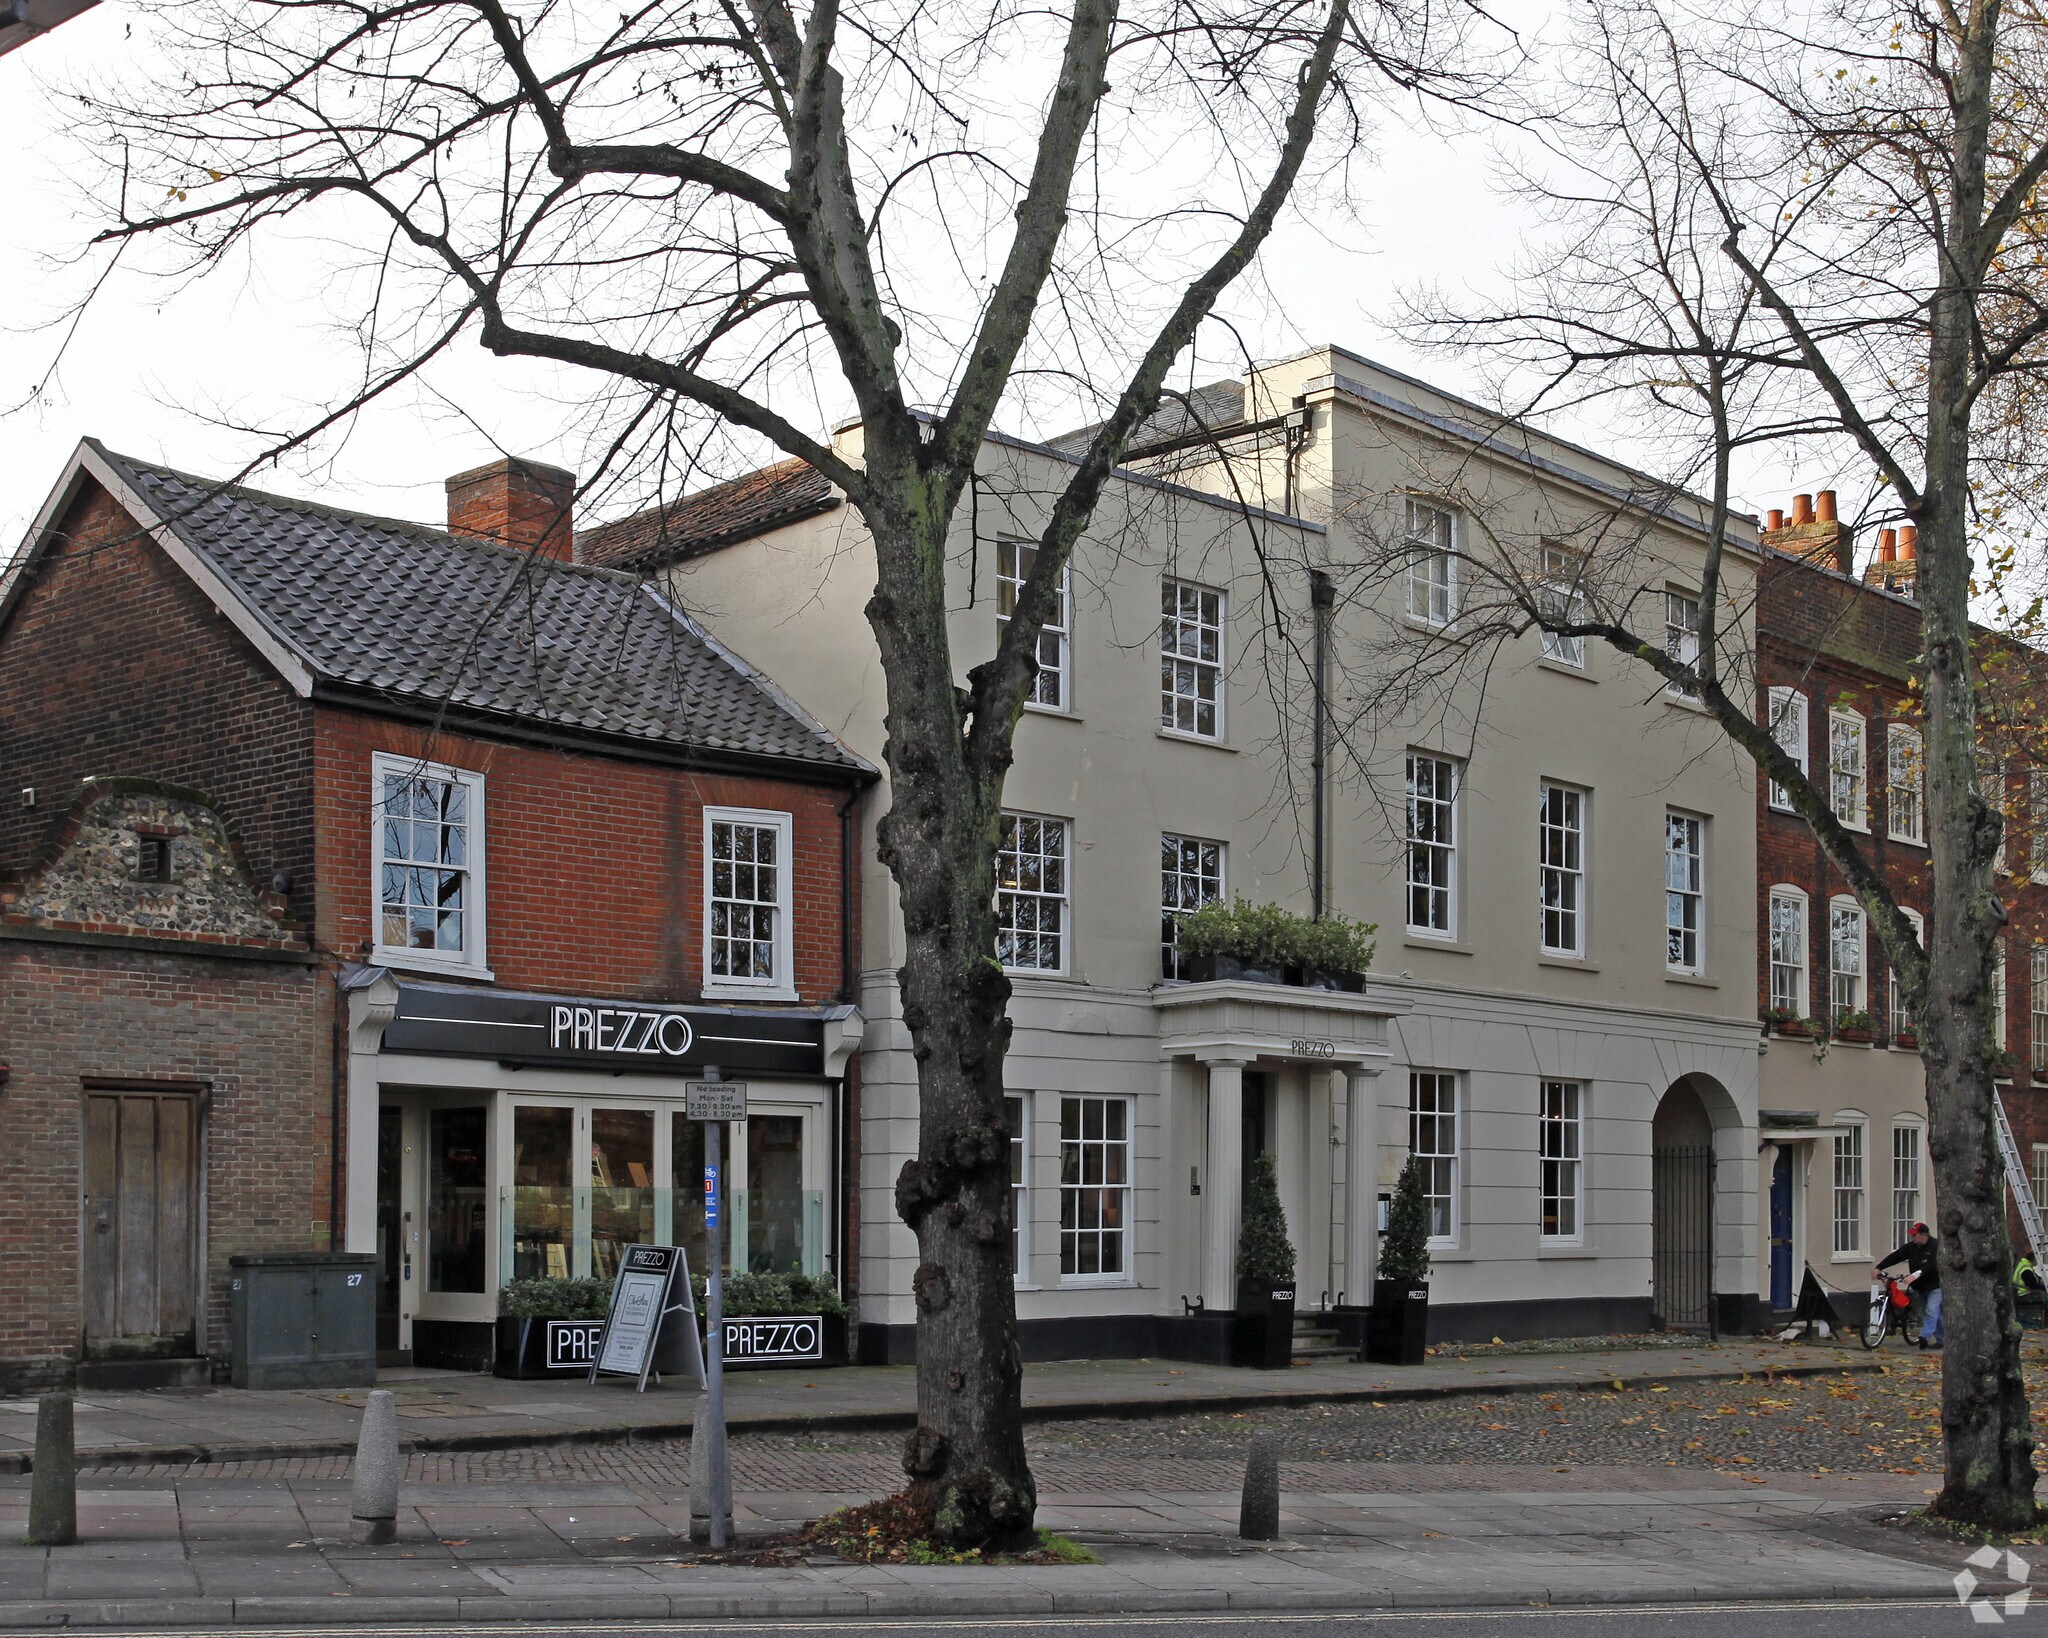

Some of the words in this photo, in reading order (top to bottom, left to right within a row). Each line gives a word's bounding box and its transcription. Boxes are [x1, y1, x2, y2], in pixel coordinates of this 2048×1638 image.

[551, 1006, 693, 1056] PREZZO
[1291, 1040, 1335, 1058] PREZZO
[633, 1250, 665, 1266] PREZZO
[232, 1279, 242, 1290] 27
[347, 1274, 362, 1286] 27
[1272, 1290, 1293, 1300] PREZZO
[1408, 1290, 1427, 1299] PREZZO
[726, 1323, 816, 1355] PREZZO
